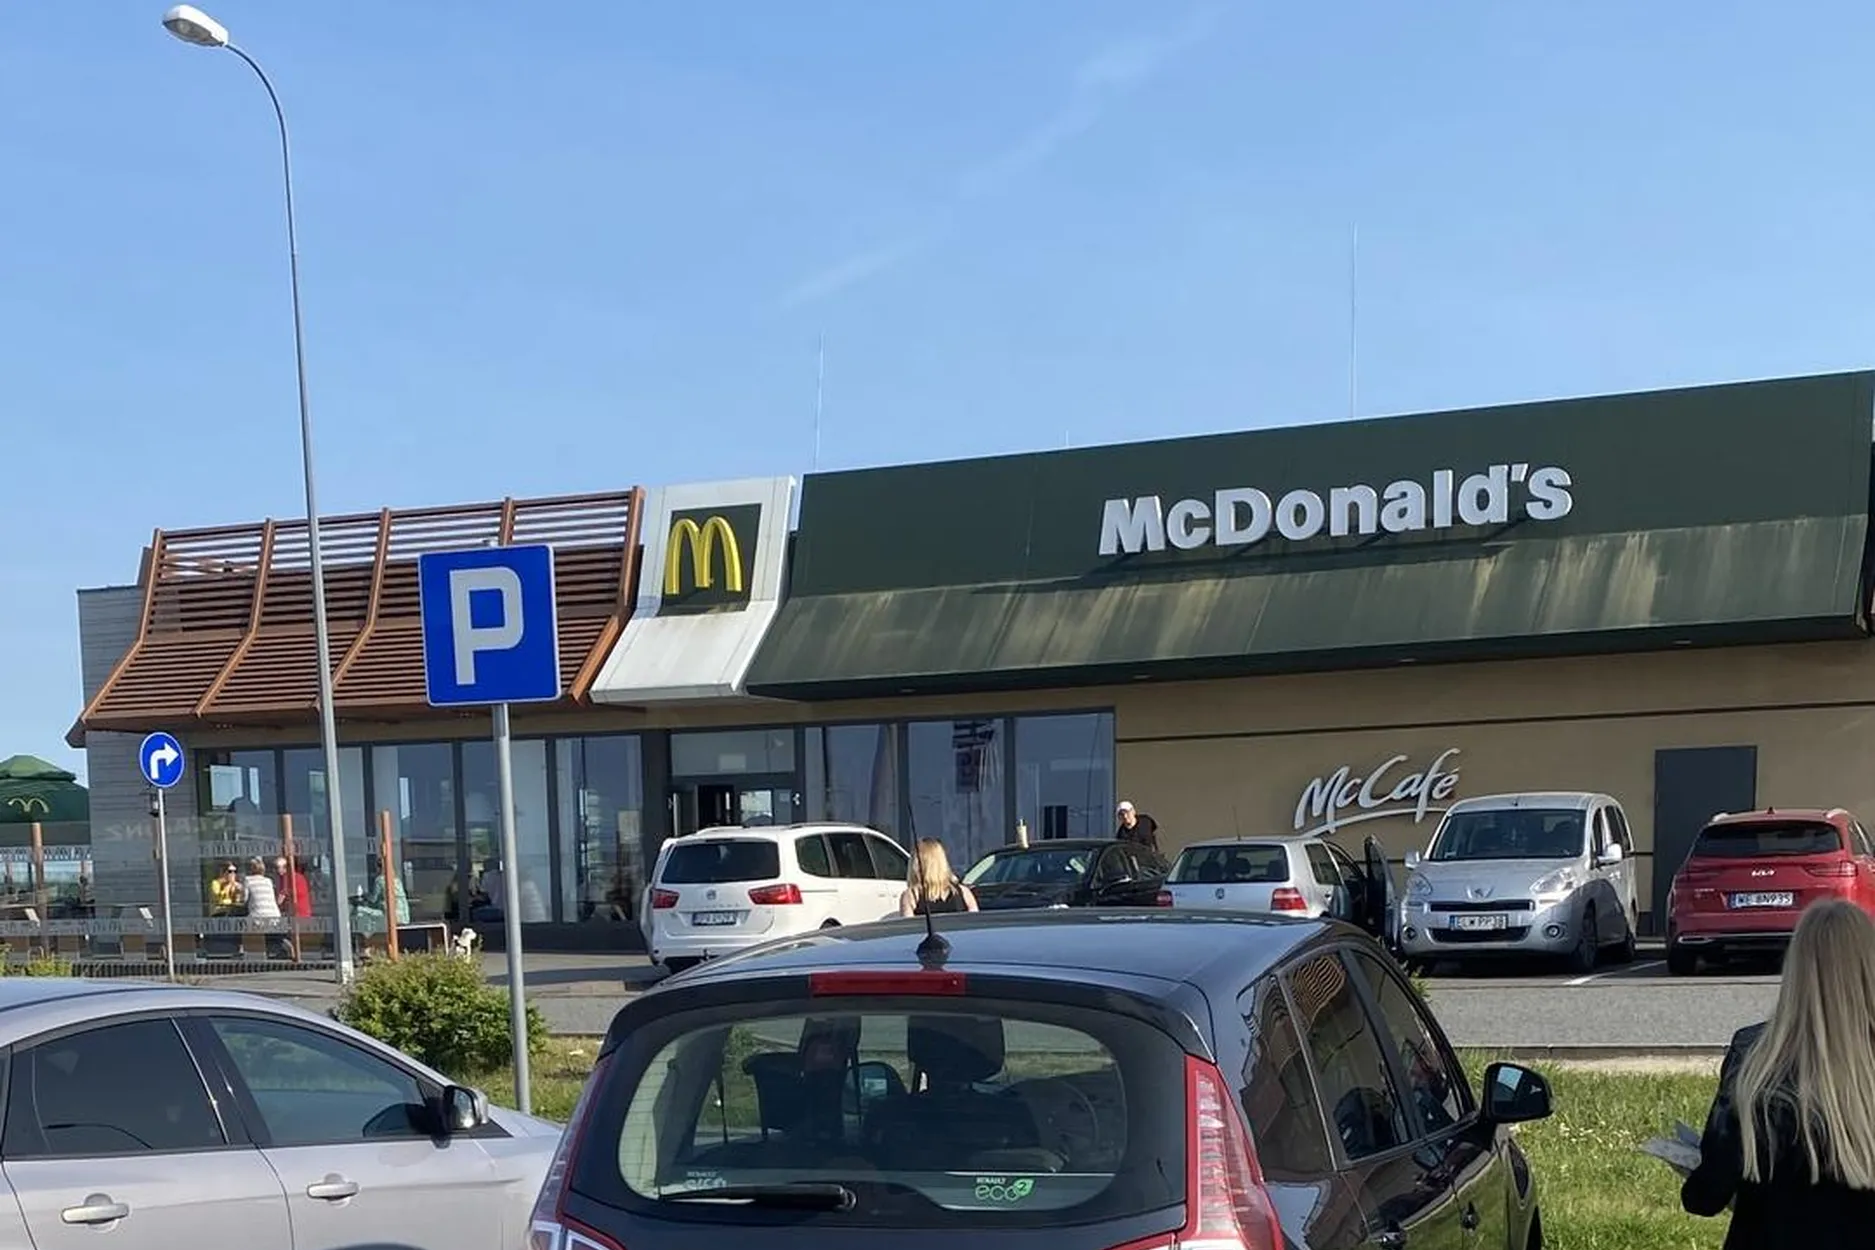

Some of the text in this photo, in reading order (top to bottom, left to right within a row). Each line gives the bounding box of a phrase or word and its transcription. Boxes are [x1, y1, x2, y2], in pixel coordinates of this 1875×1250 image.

[1098, 462, 1573, 556] McDonald's
[449, 566, 524, 685] P
[1294, 747, 1461, 834] McCafé
